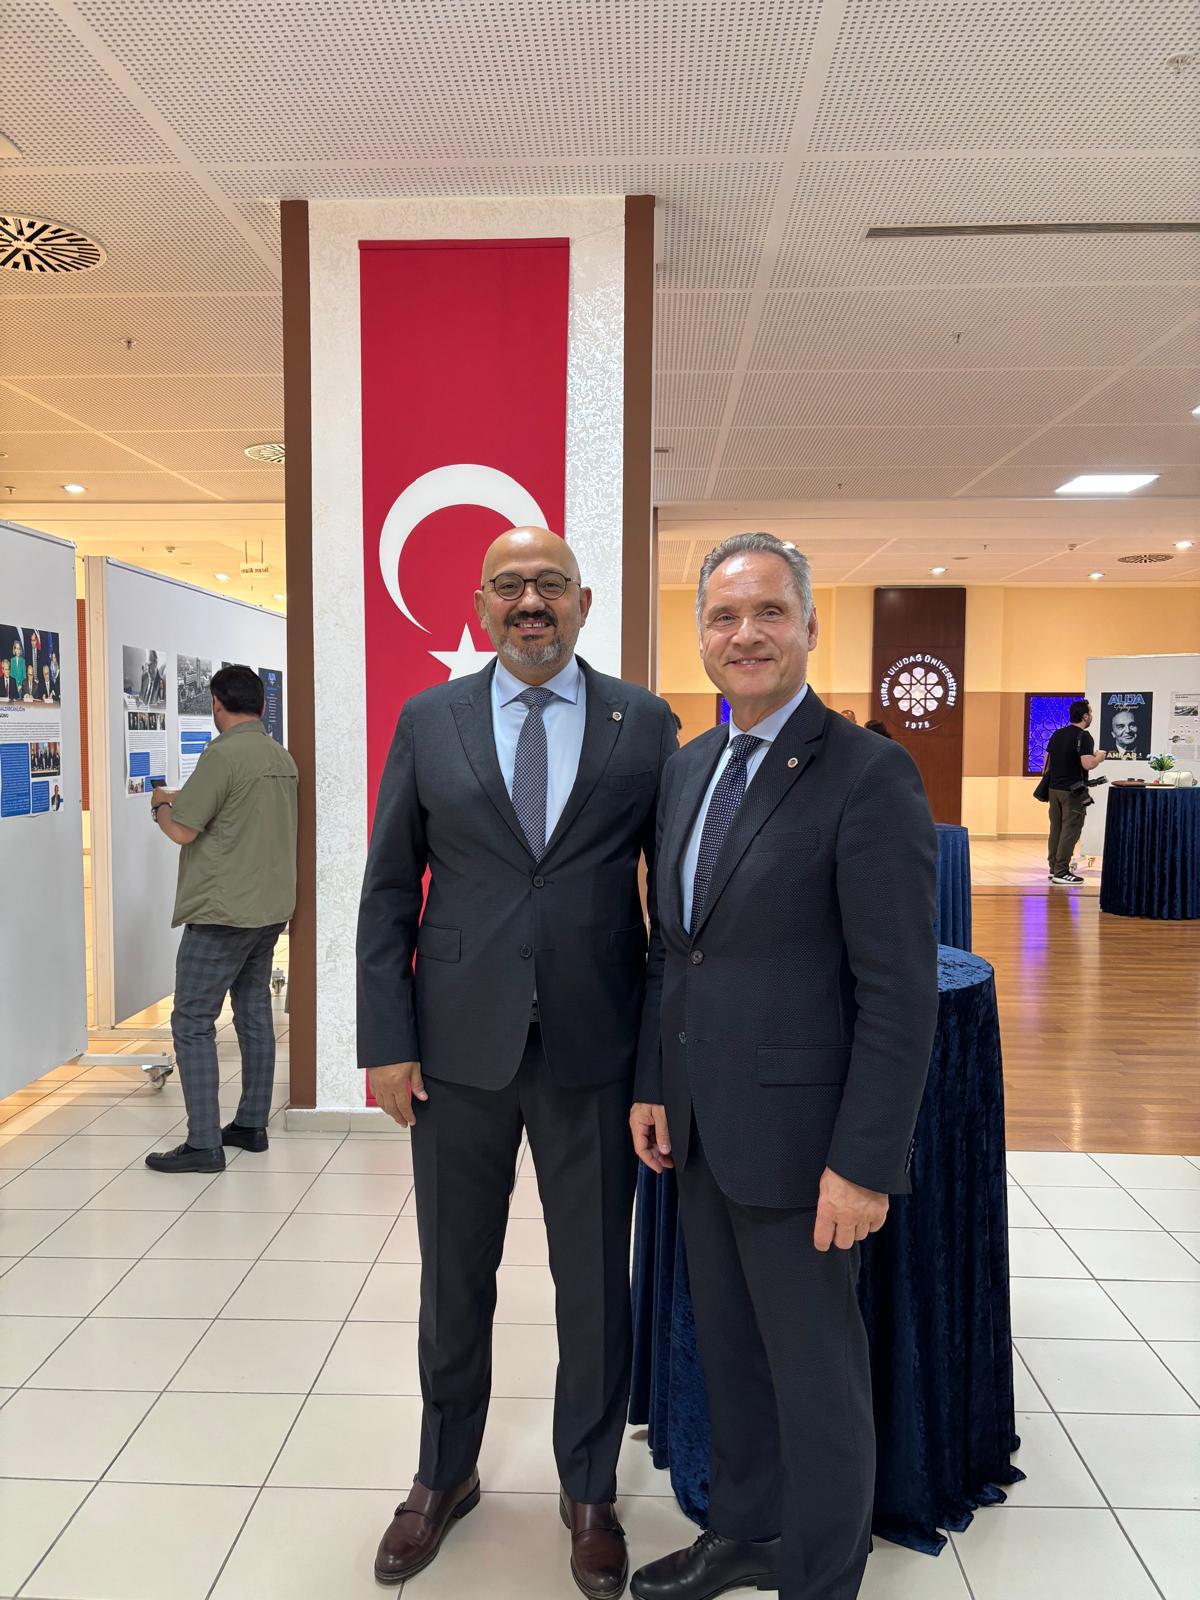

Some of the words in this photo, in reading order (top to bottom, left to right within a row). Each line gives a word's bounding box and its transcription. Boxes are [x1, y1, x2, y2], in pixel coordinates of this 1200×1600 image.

[881, 677, 891, 707] BURSA
[888, 654, 923, 676] ULUDAĞ
[905, 721, 930, 729] 1975
